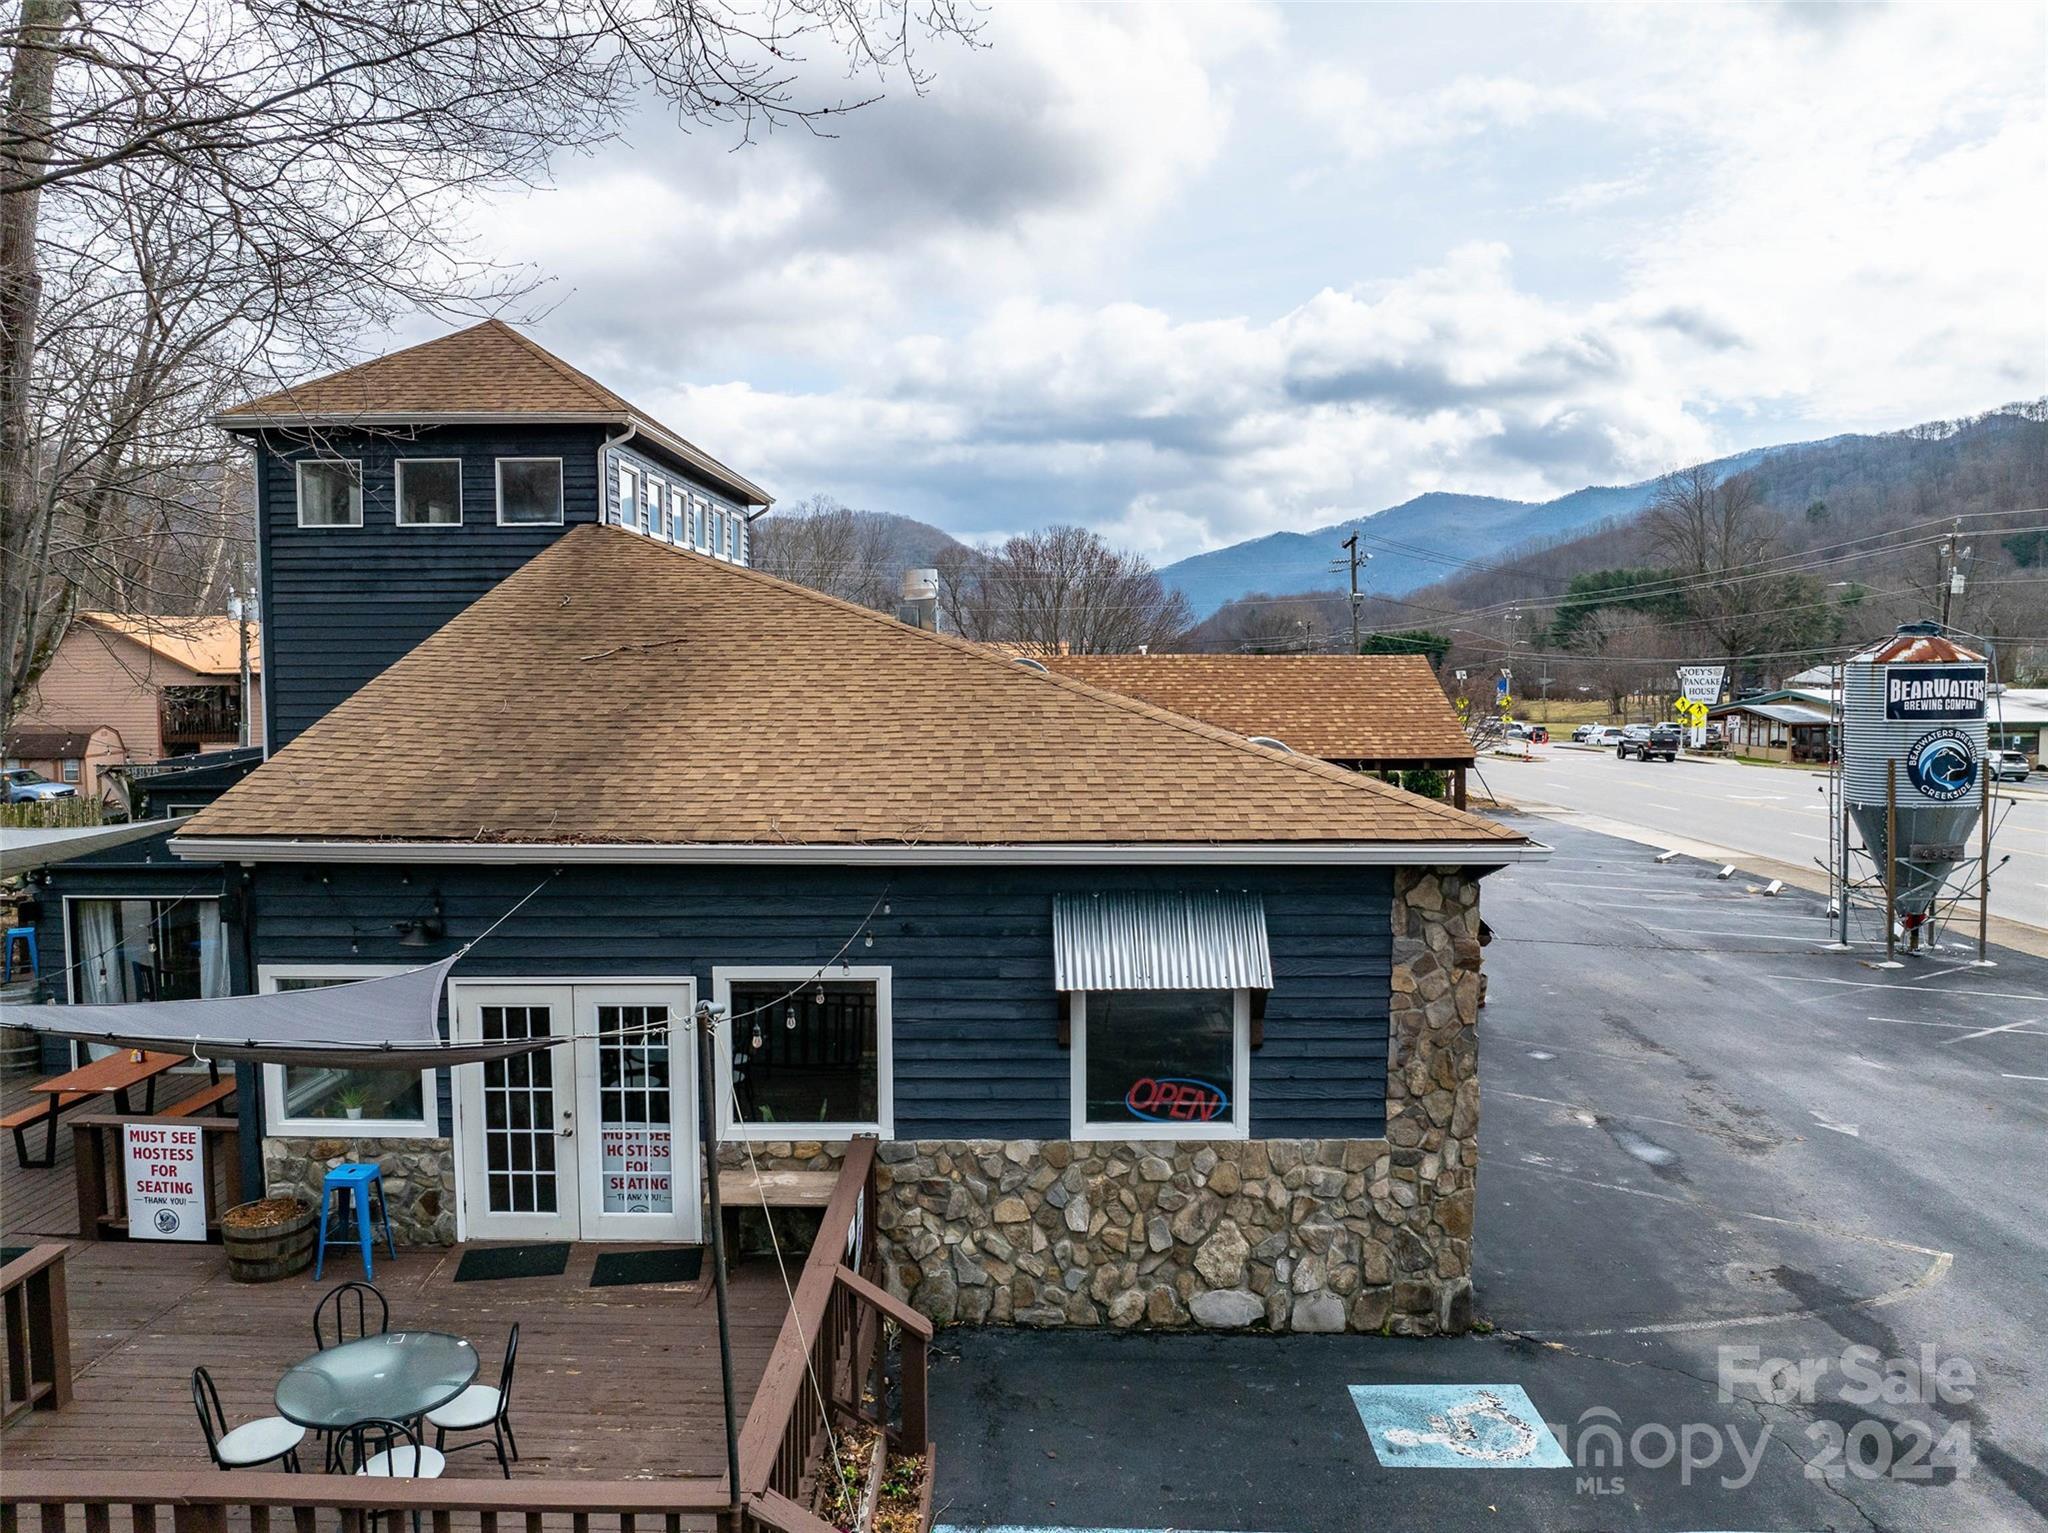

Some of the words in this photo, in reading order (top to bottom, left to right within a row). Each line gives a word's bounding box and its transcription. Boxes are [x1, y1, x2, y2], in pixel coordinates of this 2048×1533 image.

[1684, 677, 1720, 686] PANCAKE
[1688, 687, 1716, 695] HOUSE
[1890, 678, 1985, 703] BEARWATERS
[1903, 698, 1943, 711] BREWING
[1944, 698, 1977, 710] COMPANY
[1908, 729, 1954, 767] BEARWATERS
[1955, 730, 1977, 764] BREWING
[1920, 781, 1971, 800] CREEKSIDE
[1129, 1077, 1219, 1121] OPEN
[129, 1130, 166, 1143] MUST
[171, 1131, 197, 1144] SEE
[602, 1128, 642, 1140] MUST
[133, 1147, 194, 1161] HOSTESS
[607, 1144, 670, 1158] HOSTESS
[151, 1164, 177, 1177] FOR
[137, 1180, 193, 1194] SEATING
[610, 1177, 668, 1190] SEATING
[144, 1196, 168, 1205] THANK
[169, 1197, 187, 1206] YOU!
